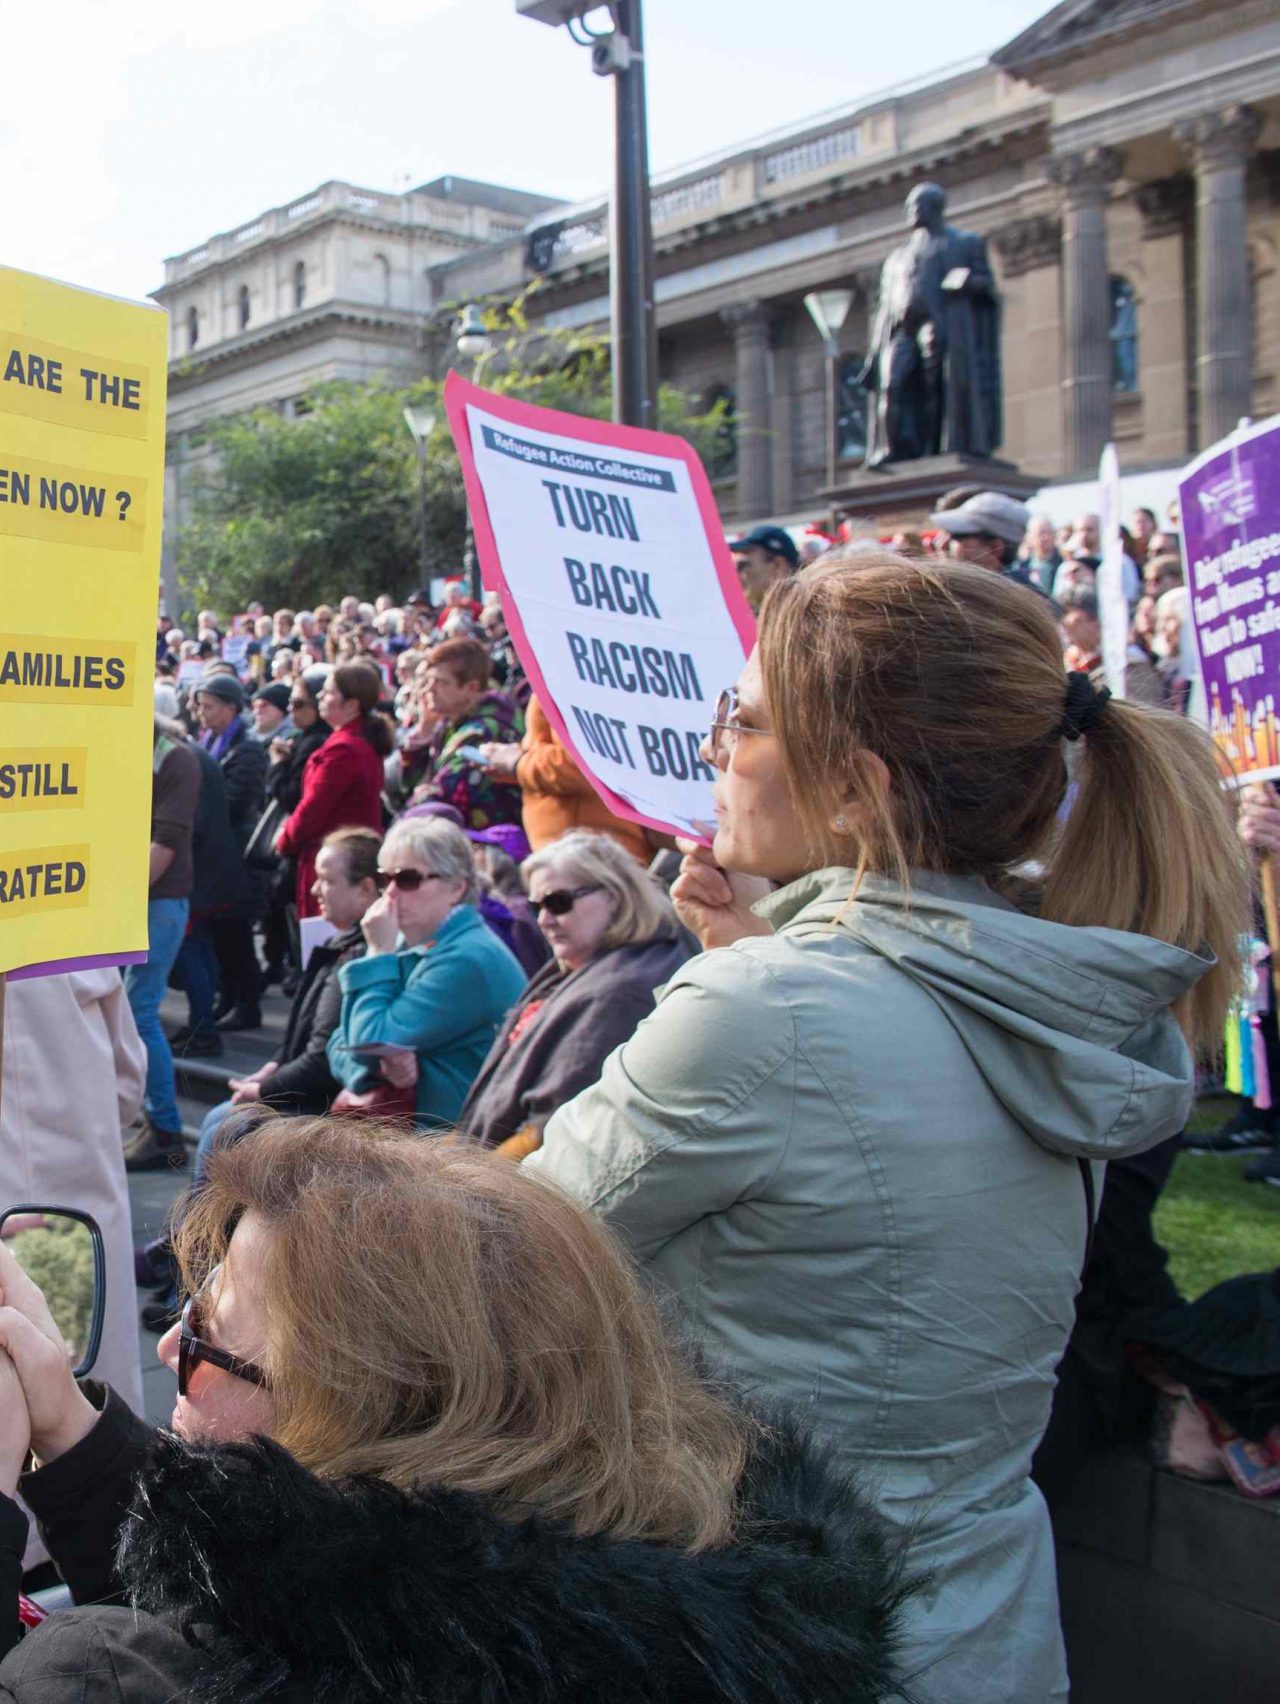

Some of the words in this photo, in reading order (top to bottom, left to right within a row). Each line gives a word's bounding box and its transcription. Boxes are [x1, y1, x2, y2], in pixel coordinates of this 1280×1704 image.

[4, 350, 62, 393] ARE
[80, 369, 140, 410] THE
[493, 432, 548, 461] Refugee
[549, 450, 595, 472] Action
[595, 461, 663, 486] Collective
[40, 478, 106, 517] NOW
[116, 491, 131, 520] ?
[542, 480, 639, 541] TURN
[564, 558, 660, 618] BACK
[567, 632, 703, 700] RACISM
[570, 705, 636, 770] NOT
[638, 725, 715, 781] BOA
